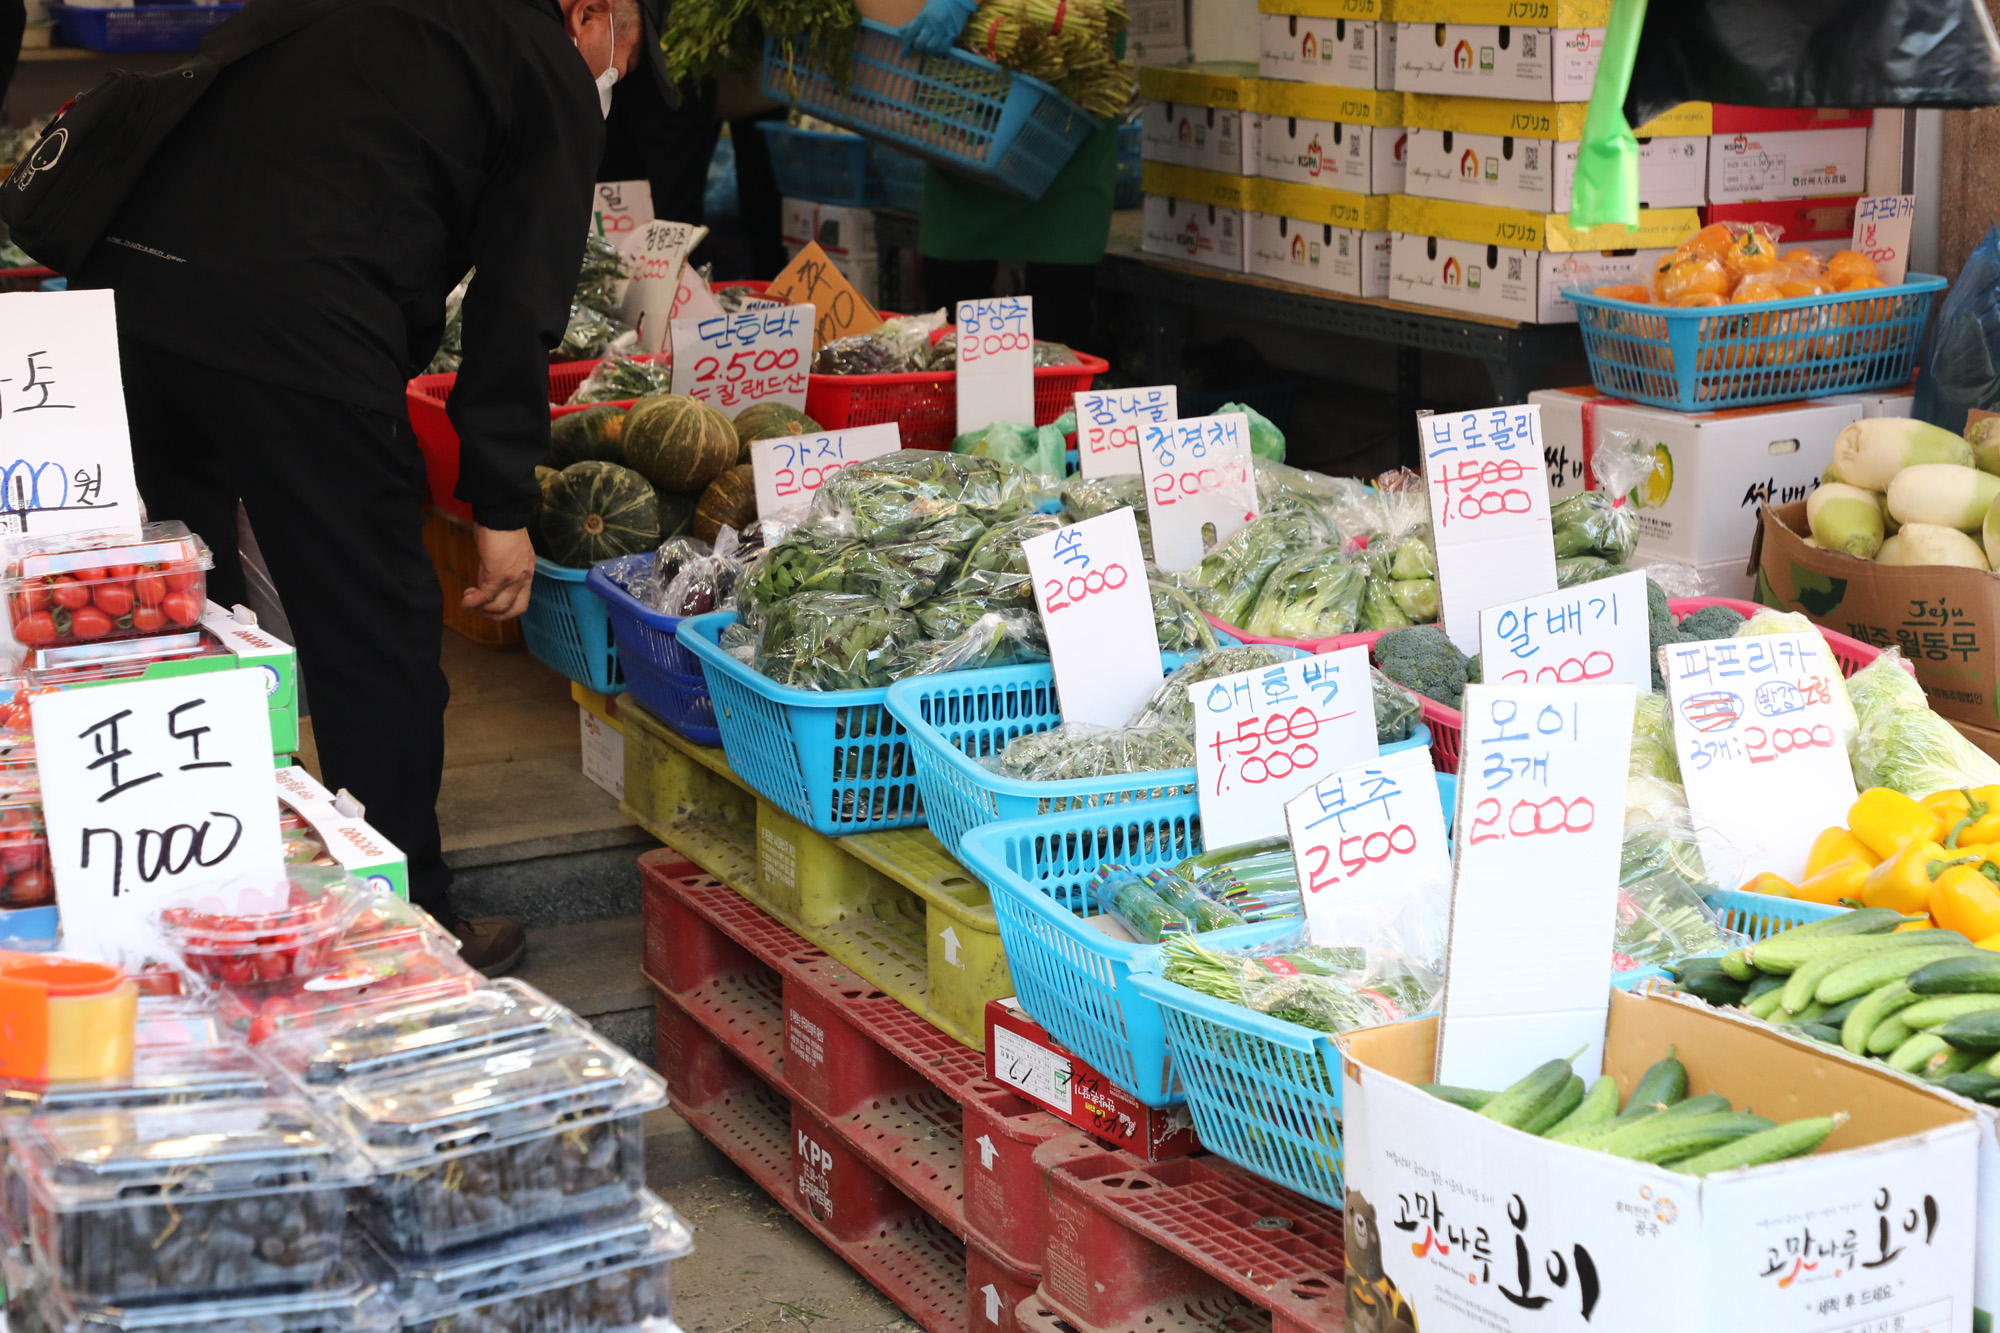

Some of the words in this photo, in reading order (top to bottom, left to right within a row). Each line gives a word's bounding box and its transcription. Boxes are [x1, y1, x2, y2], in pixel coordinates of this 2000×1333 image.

[1860, 196, 1915, 221] 파프리카
[646, 225, 686, 258] 청양고추
[698, 309, 800, 349] 단호박
[959, 299, 1029, 335] 양상추
[694, 347, 799, 382] 2.500
[1084, 391, 1169, 426] 참나물
[773, 436, 844, 467] 가지
[1146, 421, 1240, 467] 청경채
[1429, 410, 1534, 459] 브로콜리
[73, 463, 102, 505] 원
[1053, 529, 1091, 569] 쑥
[1497, 592, 1618, 659] 알배기
[1908, 597, 1964, 628] Jeju
[1676, 639, 1817, 687] 파프리카
[1206, 659, 1340, 714] 애호박
[1481, 699, 1578, 745] 오이
[78, 697, 233, 804] 포도
[1483, 750, 1550, 791] 3개
[1305, 770, 1402, 833] 부추
[798, 1128, 833, 1176] KPP
[1393, 1190, 1494, 1284] 고맛나루
[1497, 1193, 1600, 1323] 오이
[1759, 1227, 1859, 1290] 고맛나루
[1861, 1187, 1940, 1269] 오이
[1816, 1297, 1841, 1317] 세척
[1844, 1294, 1855, 1311] 후
[1860, 1285, 1895, 1307] 드세요
